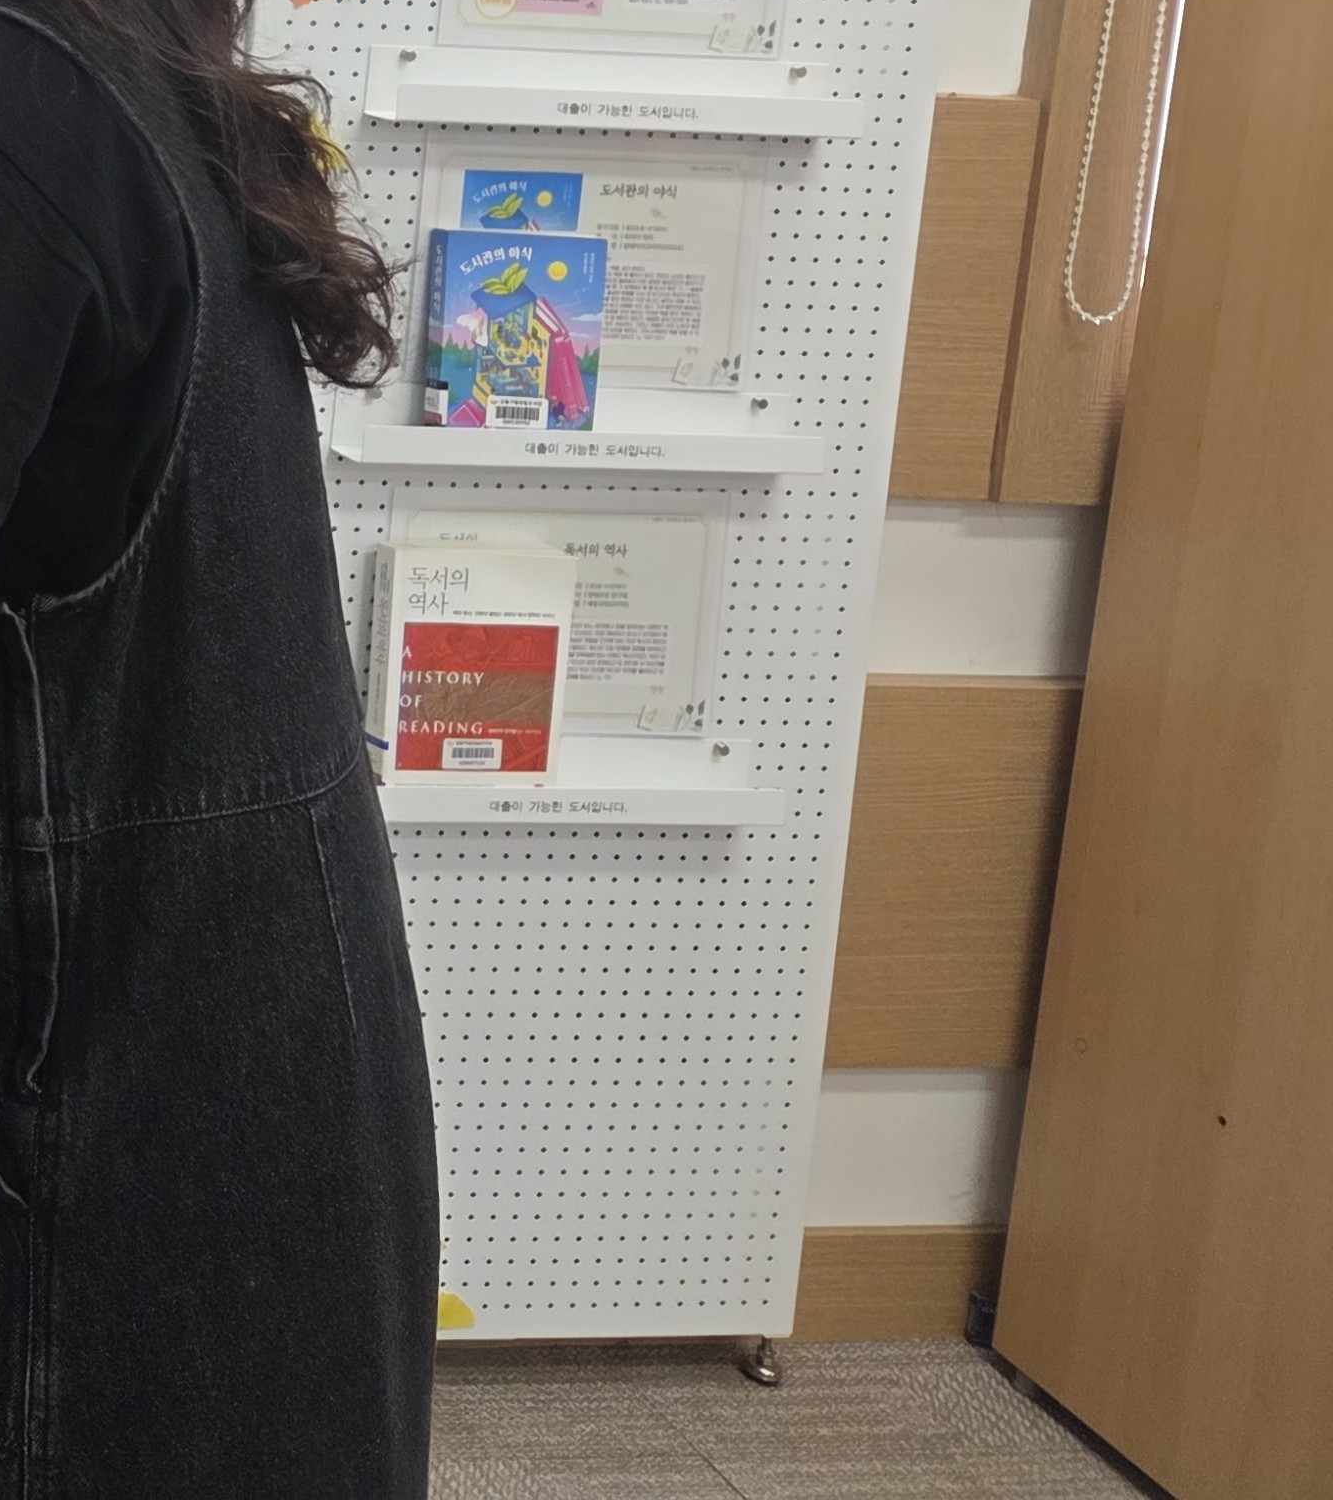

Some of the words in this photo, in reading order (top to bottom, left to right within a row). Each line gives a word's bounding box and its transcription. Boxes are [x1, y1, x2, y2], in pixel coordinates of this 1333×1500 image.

[557, 102, 592, 118] 대출이
[598, 103, 633, 119] 가능한
[638, 105, 699, 121] 도서입니다.
[600, 184, 649, 198] 도서관의
[653, 184, 677, 199] 야식
[459, 246, 505, 276] 도서관의
[525, 443, 559, 458] 대출이
[565, 443, 600, 458] 가능한
[606, 444, 666, 459] 도서입니다.
[564, 542, 600, 557] 독서의
[604, 543, 628, 558] 역사
[408, 566, 470, 592] 독서의
[408, 592, 449, 616] 역사
[401, 670, 485, 686] HISTORY
[399, 694, 422, 709] OF
[398, 720, 484, 735] READING
[489, 800, 523, 813] 대출이
[529, 800, 563, 813] 가능한
[568, 800, 628, 814] 도서입니다.
